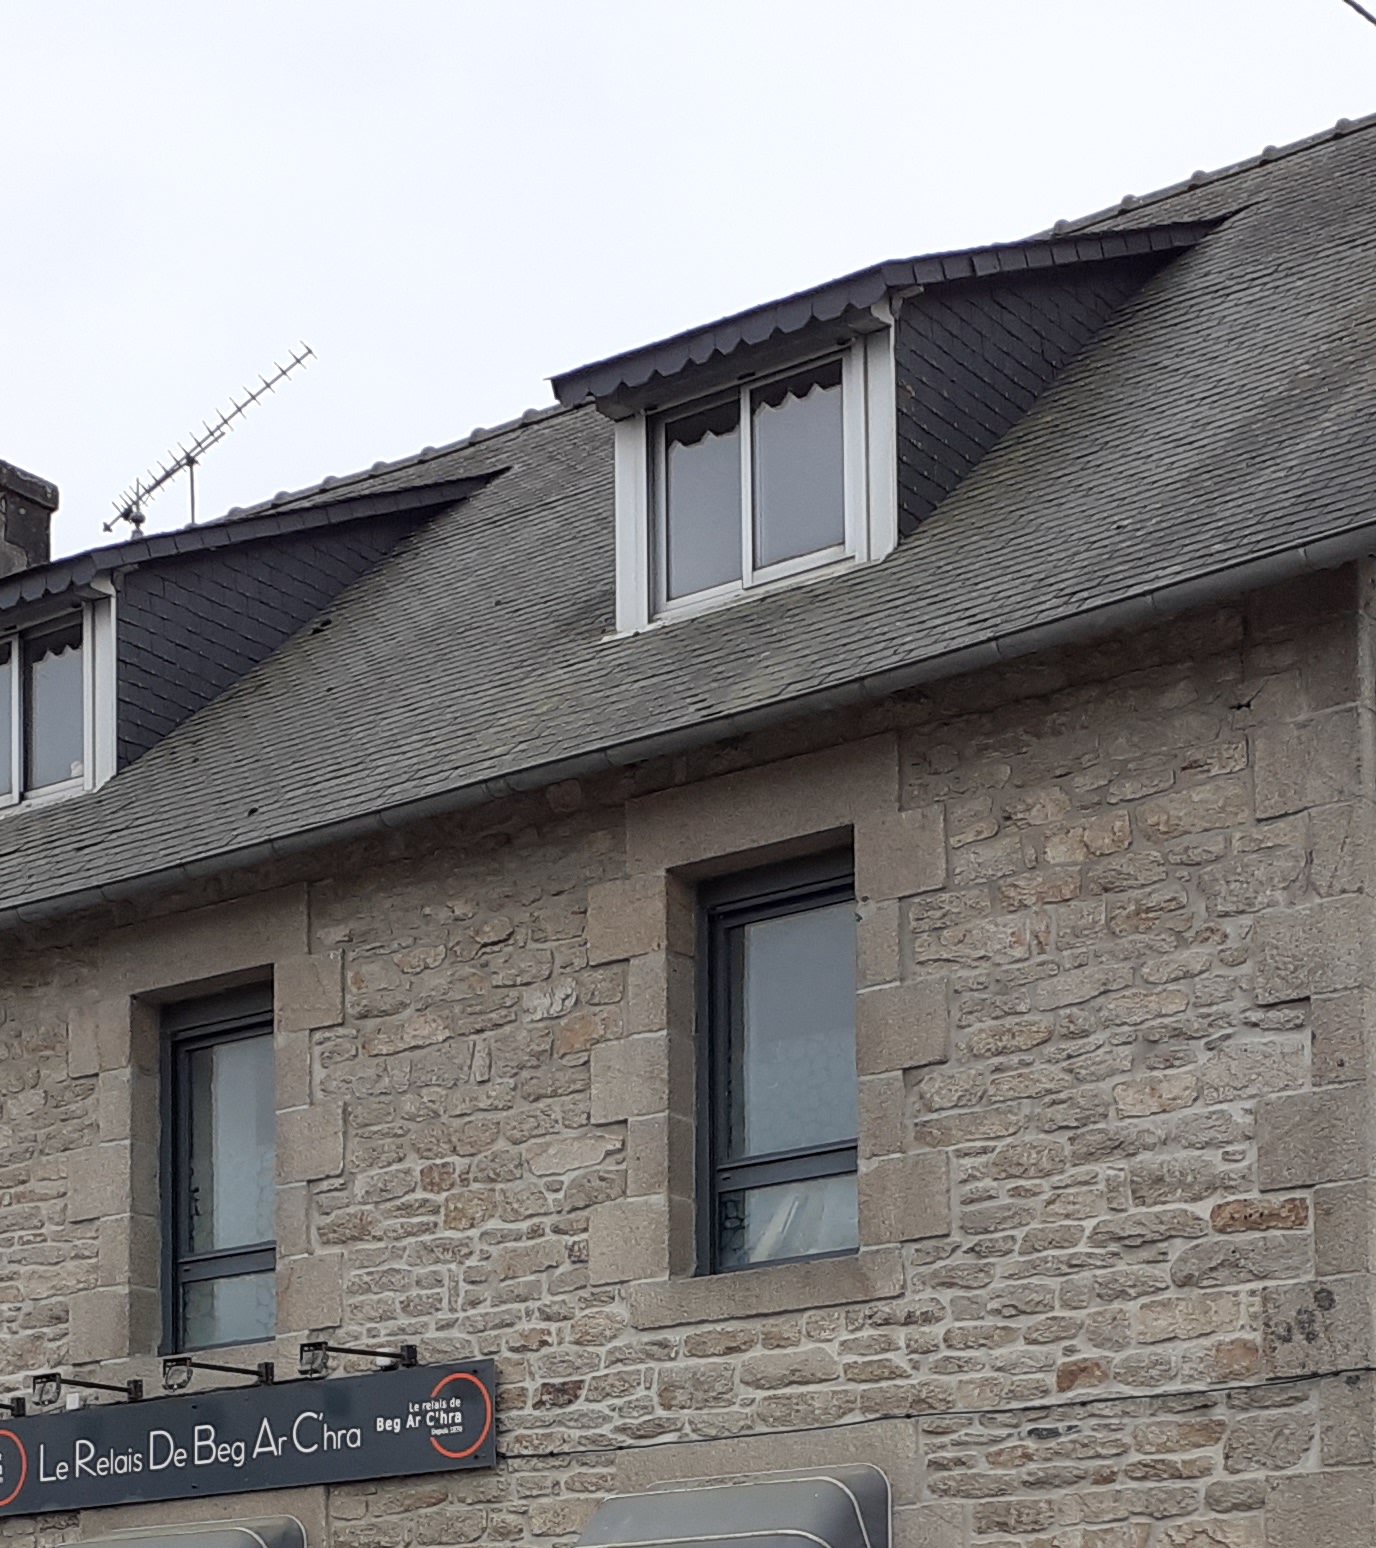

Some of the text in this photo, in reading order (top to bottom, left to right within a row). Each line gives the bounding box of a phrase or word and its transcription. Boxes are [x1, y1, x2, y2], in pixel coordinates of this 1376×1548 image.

[408, 1397, 461, 1412] Le relais de
[376, 1410, 462, 1433] Beg Ar C'hra
[39, 1411, 361, 1482] Le Relais De Beg Ar C'hra
